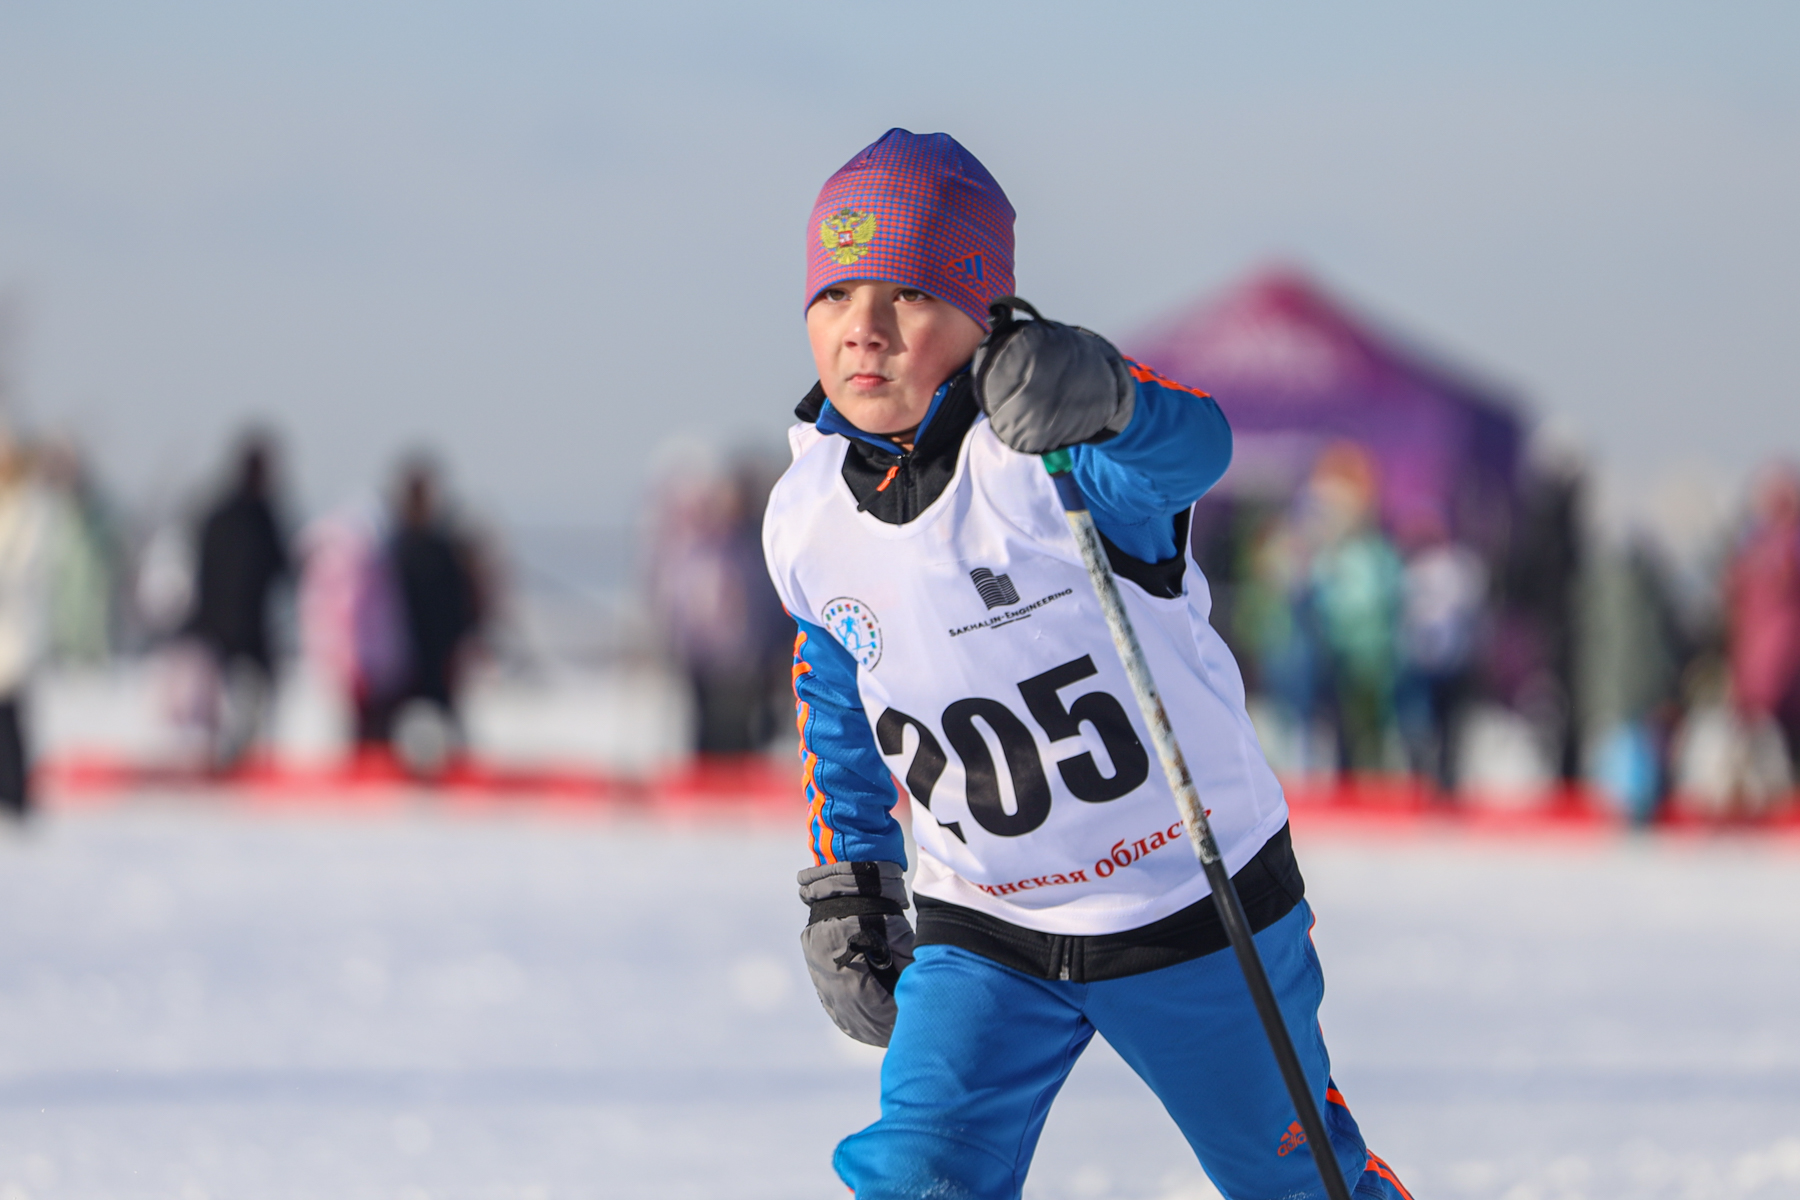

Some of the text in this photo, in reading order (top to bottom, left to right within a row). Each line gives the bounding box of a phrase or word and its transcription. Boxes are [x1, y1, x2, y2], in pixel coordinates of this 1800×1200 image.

[876, 653, 1149, 845] 205
[972, 808, 1212, 897] инская облас
